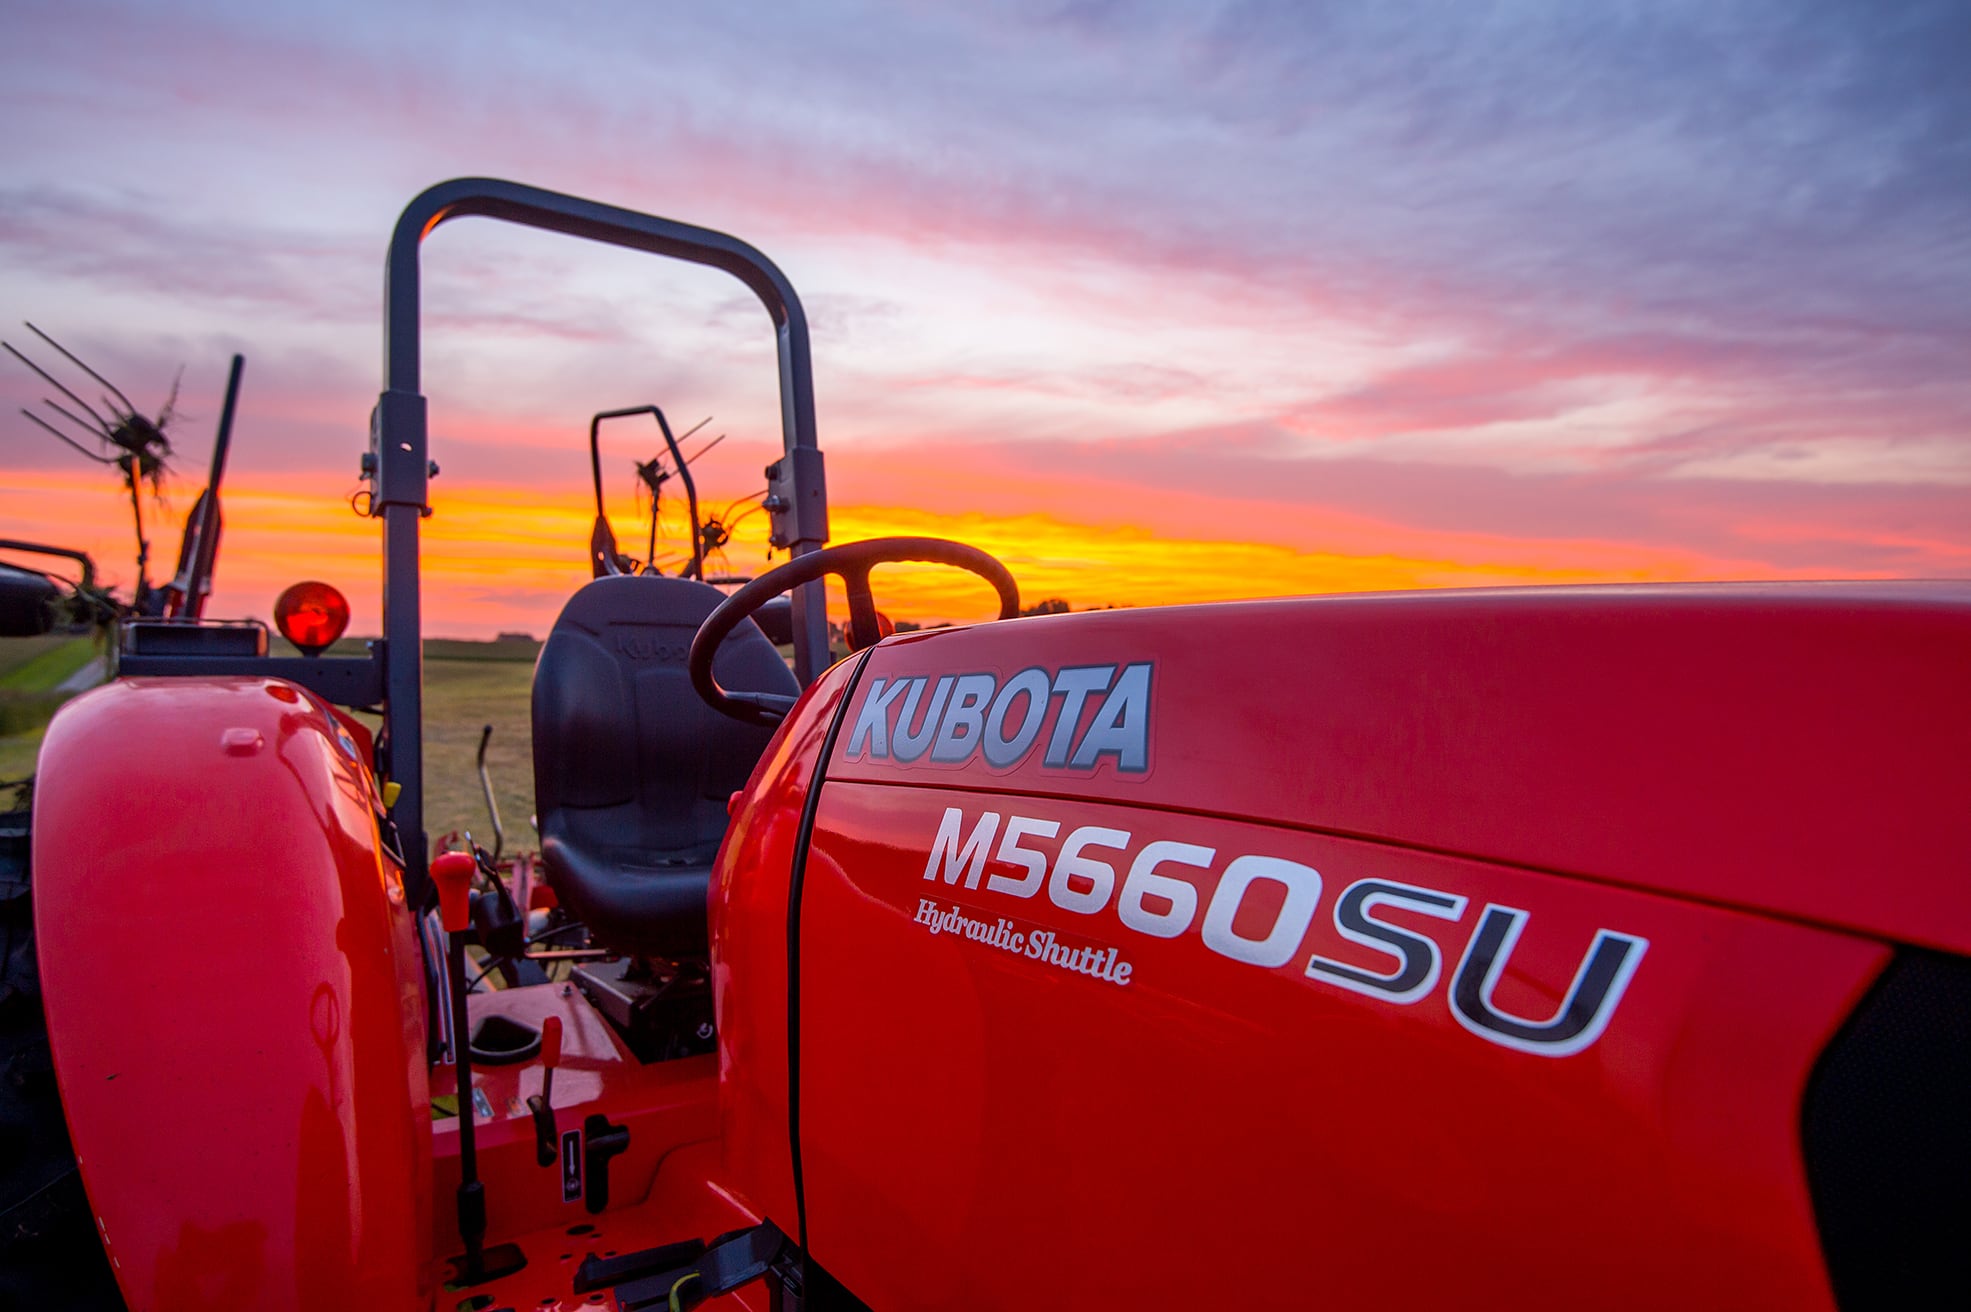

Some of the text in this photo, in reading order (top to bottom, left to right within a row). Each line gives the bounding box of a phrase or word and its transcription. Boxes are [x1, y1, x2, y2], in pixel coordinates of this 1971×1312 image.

[614, 633, 692, 662] Kubo
[846, 662, 1153, 772] KUBOTA
[914, 898, 1133, 985] Hydraulic Shuttle
[922, 807, 1649, 1057] M5660SU
